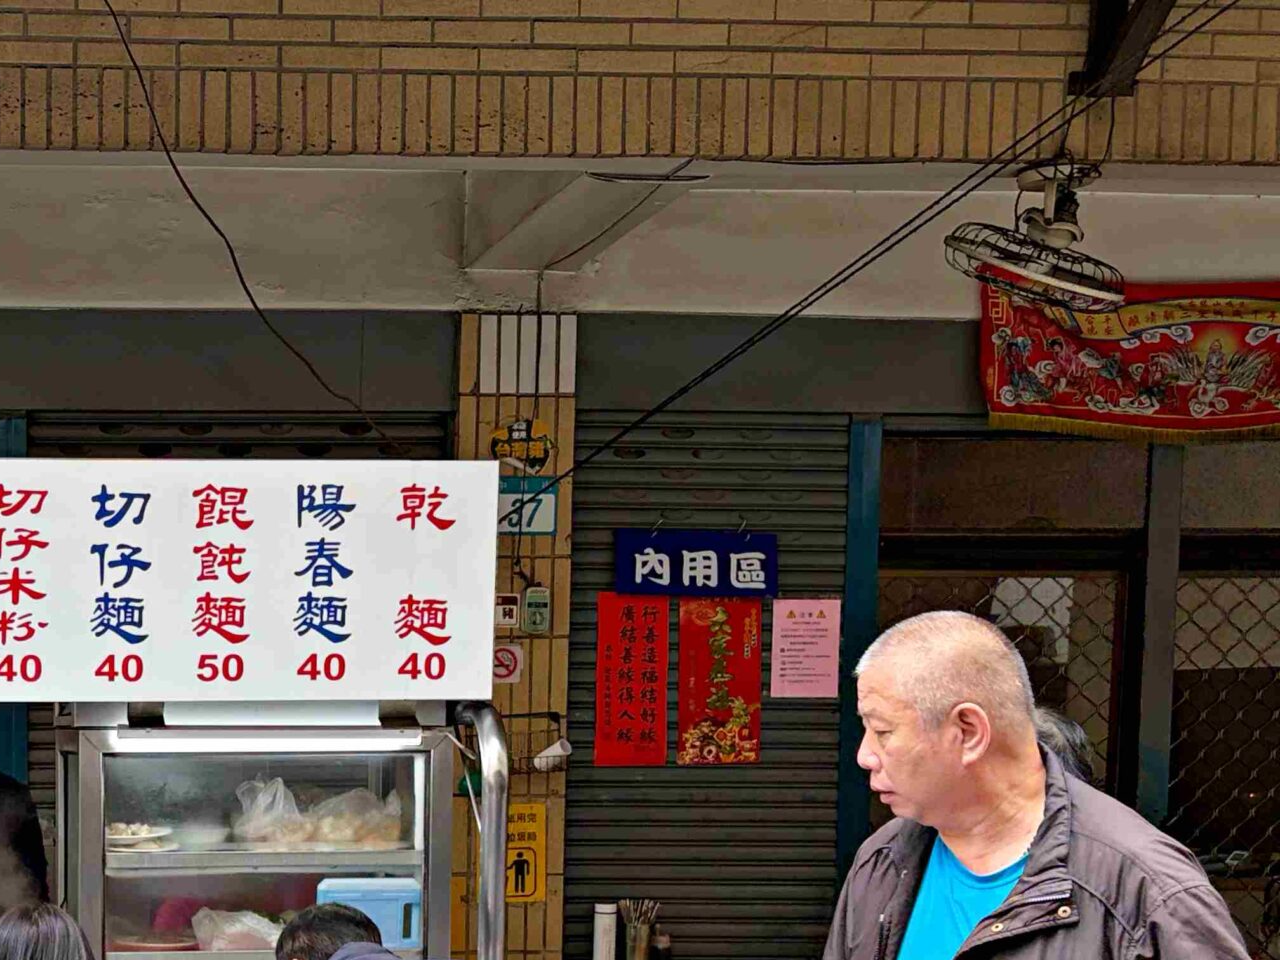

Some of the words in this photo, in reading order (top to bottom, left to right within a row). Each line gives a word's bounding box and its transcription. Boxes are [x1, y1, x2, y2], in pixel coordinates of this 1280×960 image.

[90, 484, 151, 644] 切仔麵
[192, 484, 254, 644] 餛飩麵
[294, 483, 356, 645] 陽春麵
[394, 483, 456, 646] 乾麵
[634, 547, 767, 590] 內用區
[94, 653, 144, 682] 40
[197, 653, 244, 682] 50
[296, 653, 346, 681] 40
[397, 653, 446, 681] 40
